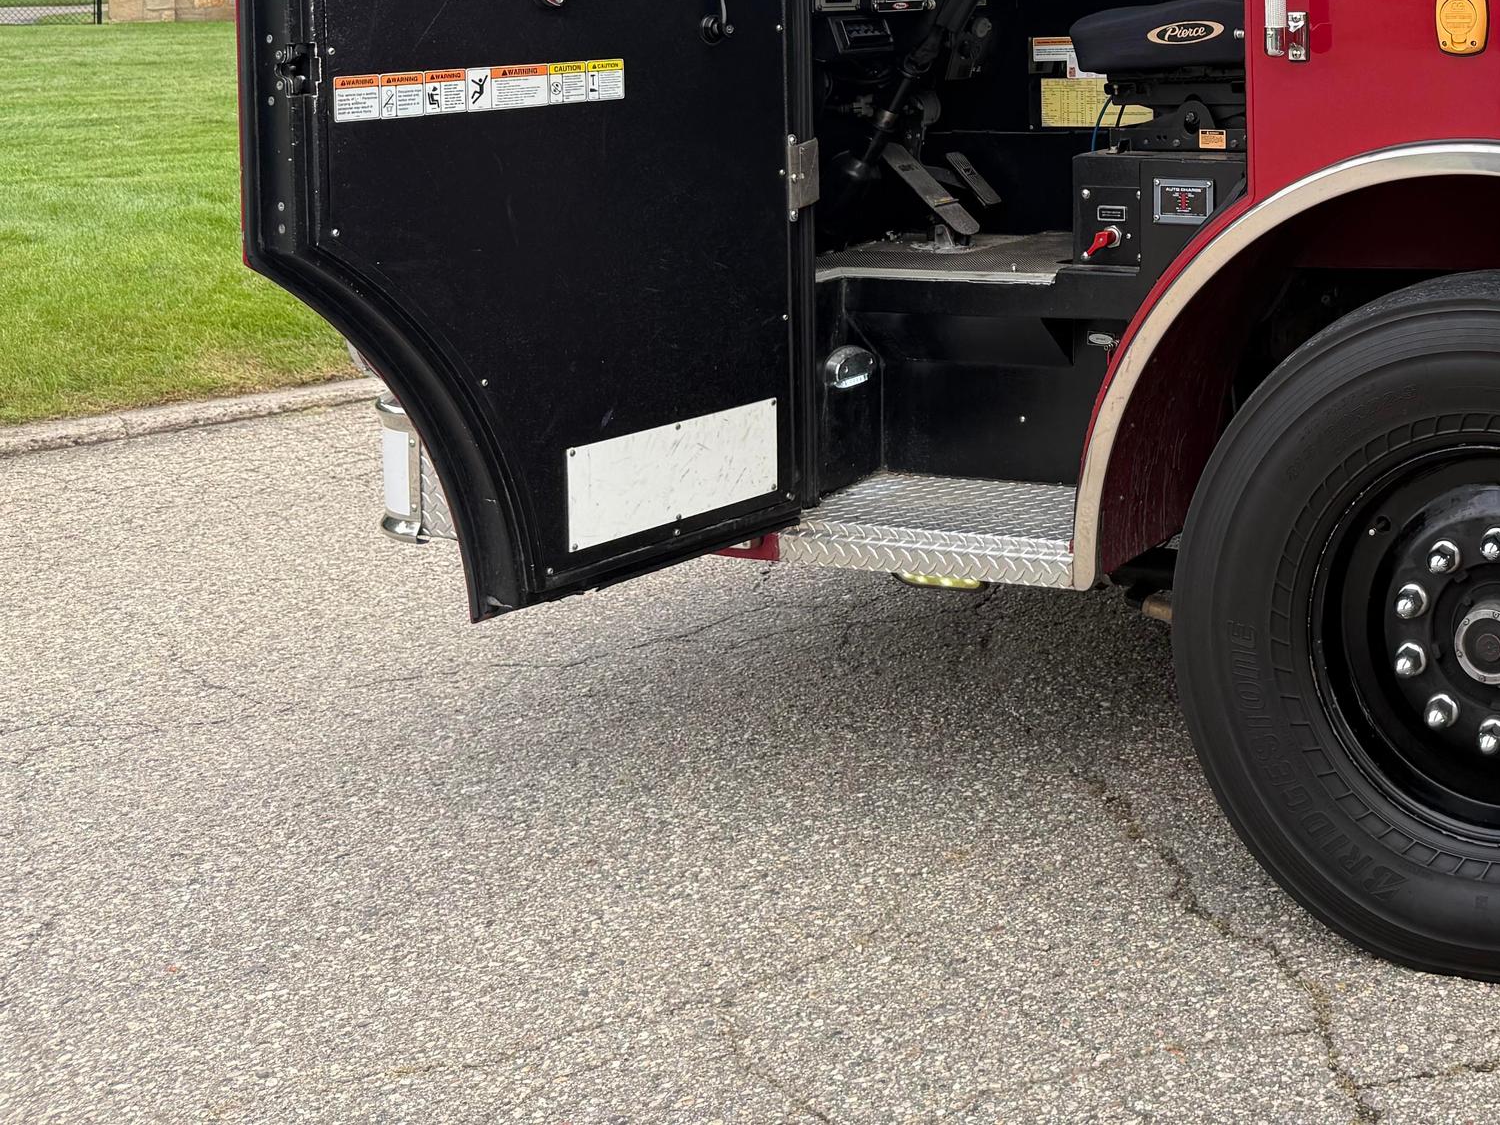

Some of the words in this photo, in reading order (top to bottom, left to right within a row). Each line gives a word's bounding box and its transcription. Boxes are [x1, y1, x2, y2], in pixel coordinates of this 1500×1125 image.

[1164, 25, 1207, 41] Pierce
[554, 64, 582, 72] CAUTION
[346, 78, 374, 86] WARNING
[392, 75, 418, 83] WARNING
